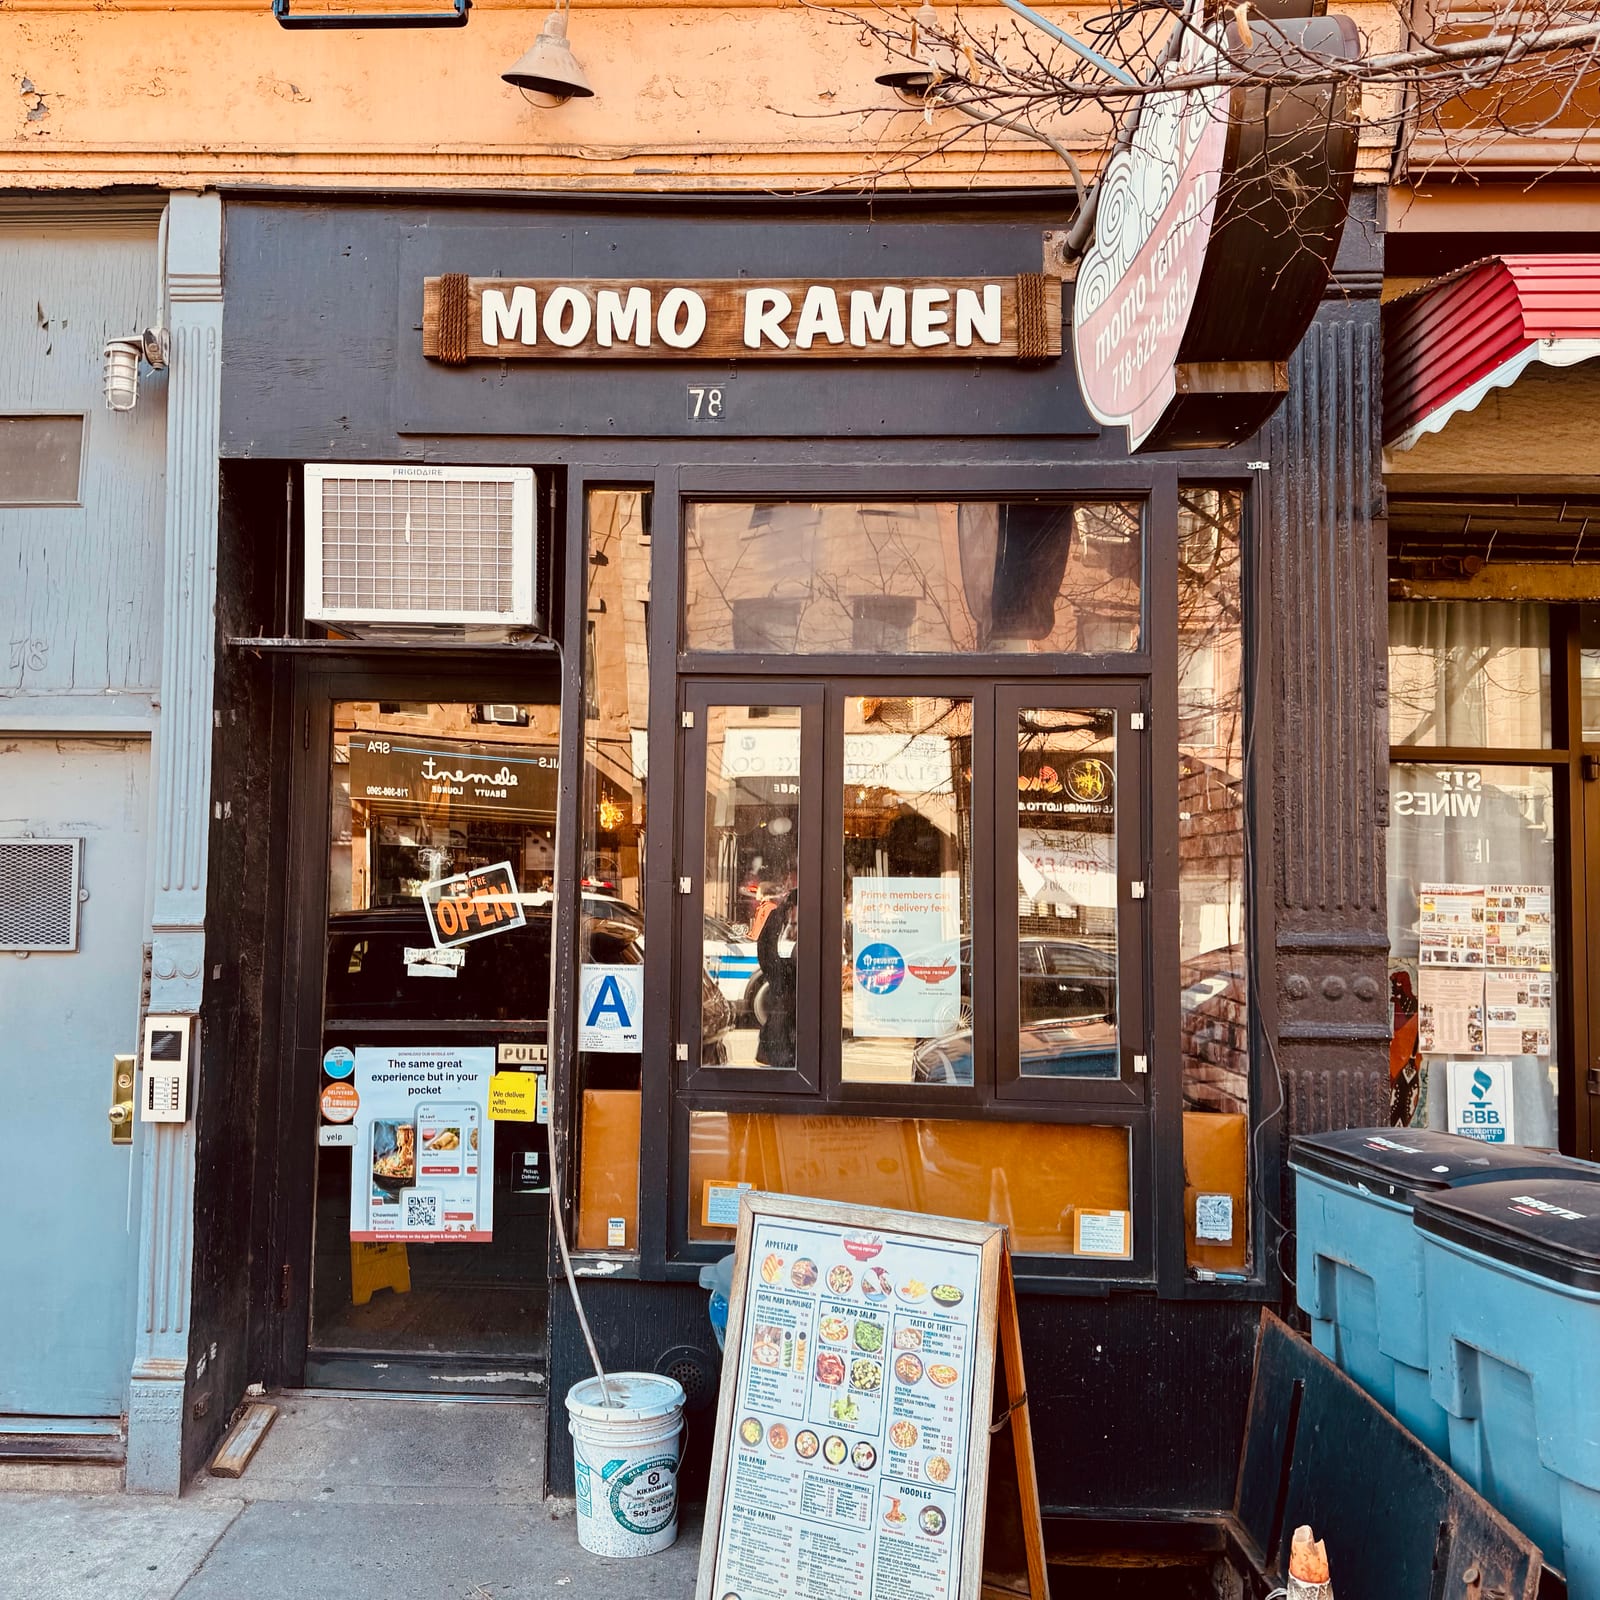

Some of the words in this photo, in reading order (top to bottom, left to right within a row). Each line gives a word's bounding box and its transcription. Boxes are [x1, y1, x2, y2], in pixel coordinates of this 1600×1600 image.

[1095, 274, 1146, 374] momo
[1149, 175, 1208, 292] ramen
[481, 285, 707, 350] MOMO
[744, 284, 1002, 350] RAMEN
[688, 388, 722, 416] 78
[392, 468, 444, 477] FRIGIDAIRE
[861, 890, 887, 899] Prime
[889, 891, 932, 899] members
[437, 882, 515, 936] OPEN
[893, 903, 928, 913] delivery
[585, 975, 632, 1027] A
[504, 1048, 547, 1061] PULL
[388, 1059, 406, 1069] The
[408, 1061, 435, 1069] same
[437, 1059, 462, 1070] great
[371, 1073, 425, 1083] experience
[427, 1073, 443, 1081] but
[446, 1073, 454, 1081] in
[456, 1074, 479, 1083] your
[408, 1086, 442, 1097] pocket
[492, 1107, 528, 1116] Postmates.
[1462, 1110, 1500, 1124] BBB
[326, 1133, 343, 1142] yelp
[1461, 1128, 1503, 1136] ACCREDITED
[1510, 1196, 1587, 1220] BRUTE
[764, 1240, 799, 1252] APPETIZER
[758, 1294, 771, 1302] HOME
[773, 1296, 785, 1304] MADE
[786, 1299, 813, 1310] DUMPLINGS
[831, 1306, 845, 1315] SOUP
[846, 1308, 858, 1317] AND
[859, 1310, 878, 1320] SALAD
[910, 1319, 926, 1329] TASTE
[927, 1321, 935, 1330] OF
[936, 1322, 953, 1332] TIBET
[628, 1467, 642, 1478] ALL
[636, 1483, 669, 1496] KIKKOMAN
[899, 1486, 932, 1500] NOODLES
[627, 1501, 646, 1510] Less
[649, 1492, 675, 1506] Sodium
[633, 1509, 649, 1518] Soy
[651, 1502, 673, 1514] Sauce
[733, 1505, 757, 1517] NON-VEG
[758, 1510, 777, 1521] RAMEN
